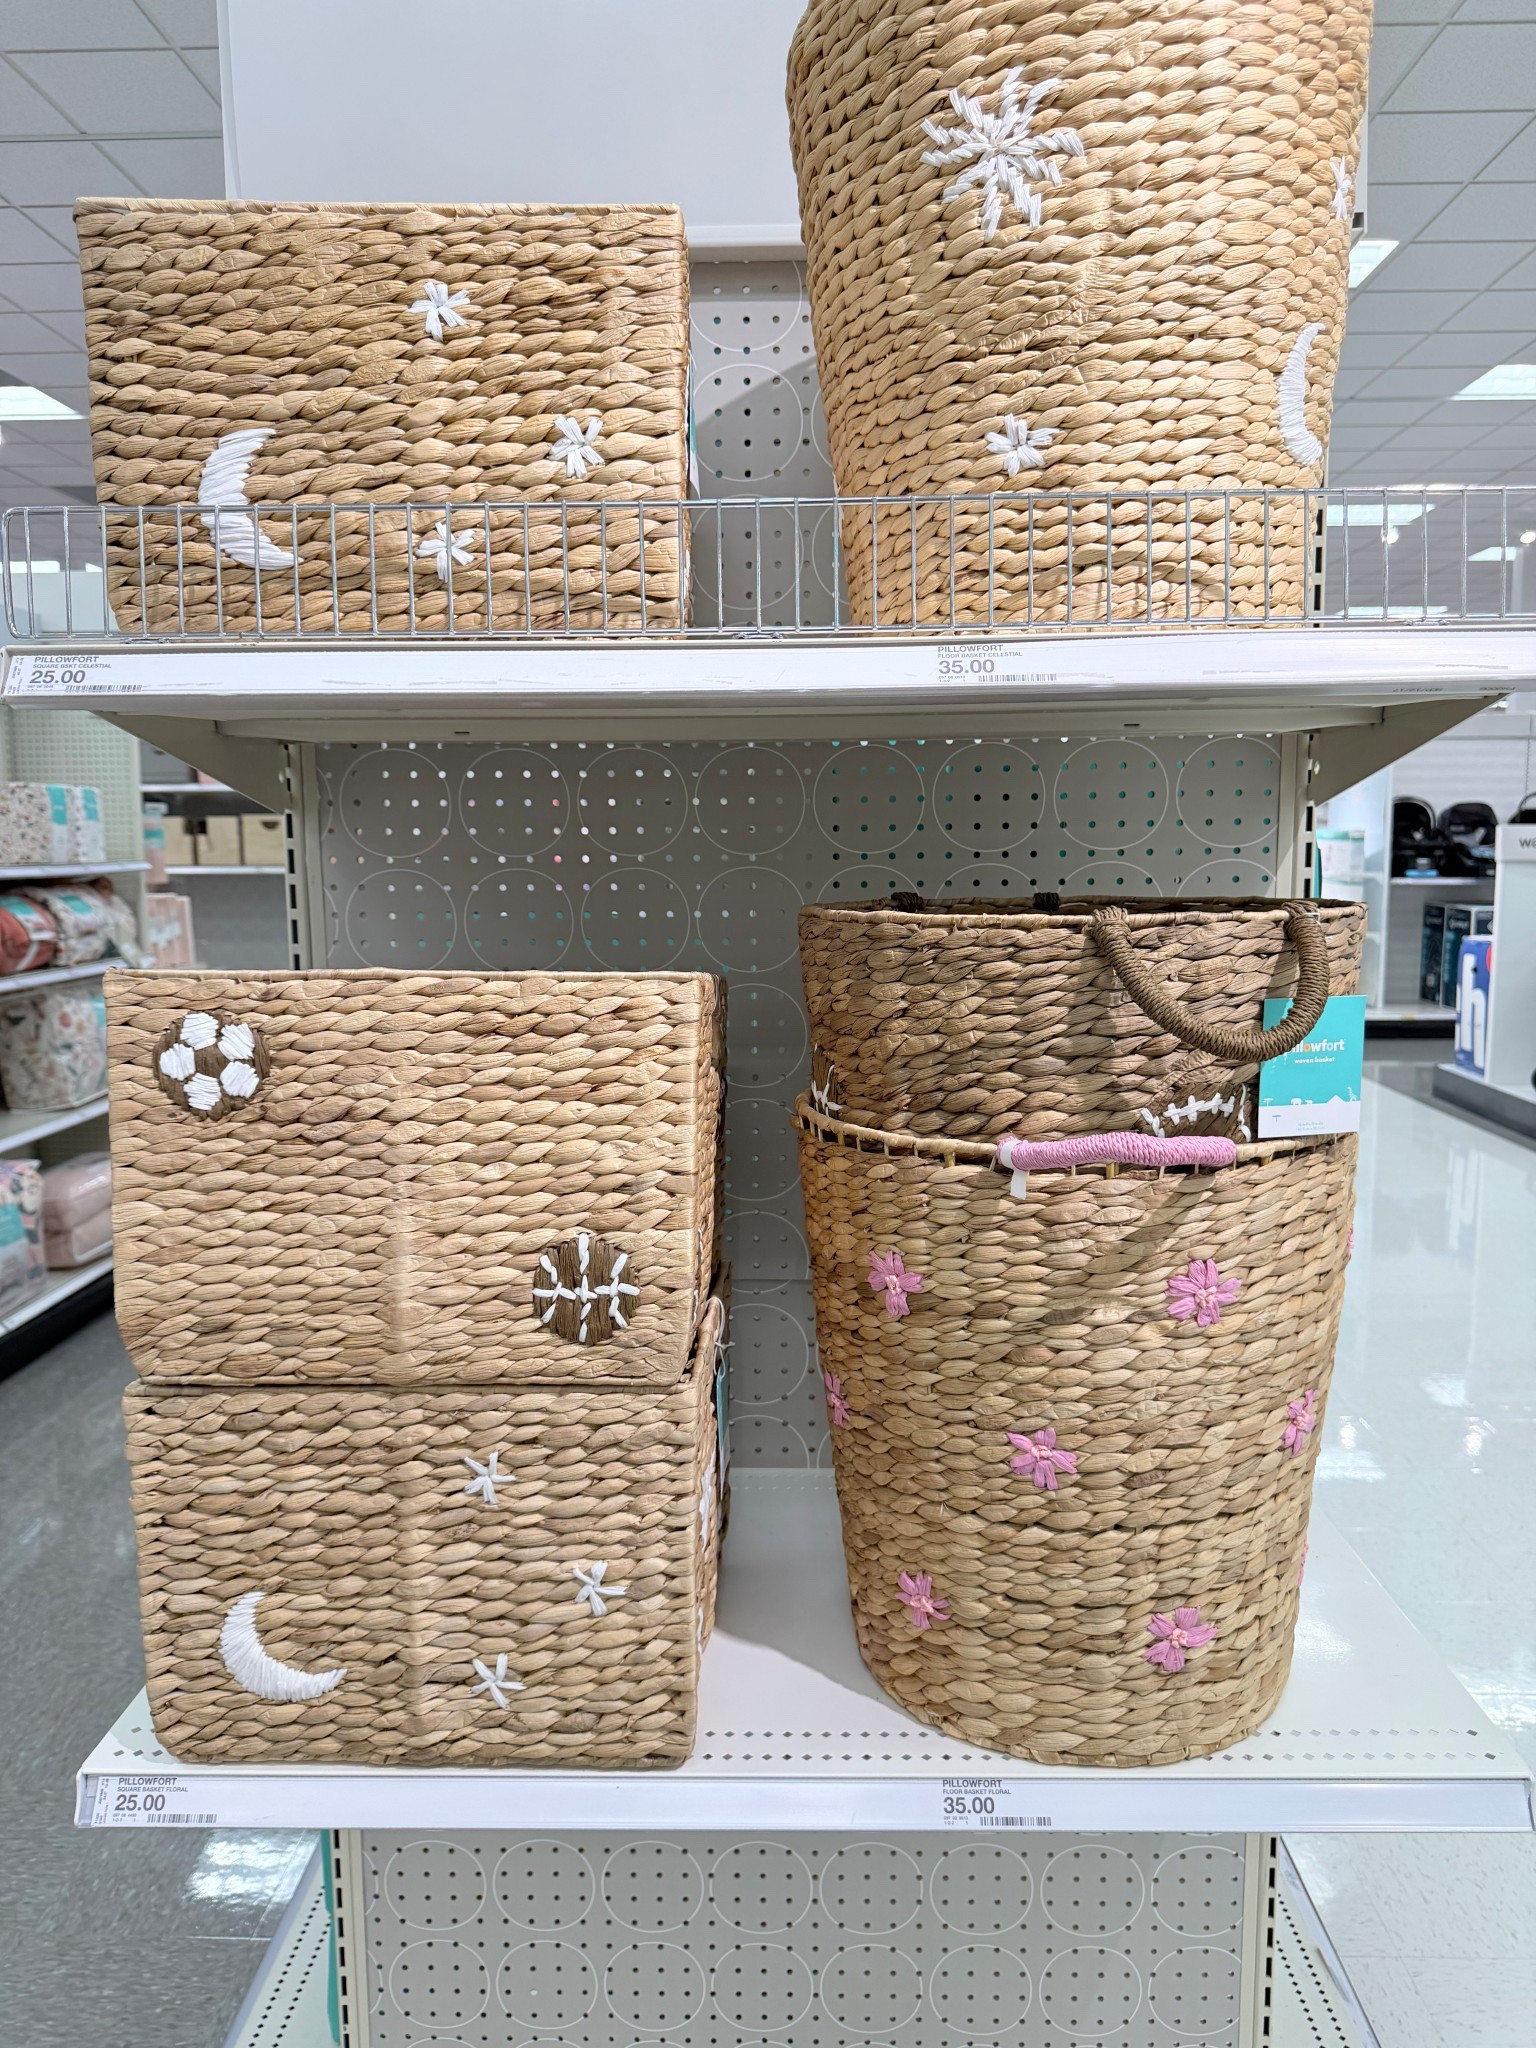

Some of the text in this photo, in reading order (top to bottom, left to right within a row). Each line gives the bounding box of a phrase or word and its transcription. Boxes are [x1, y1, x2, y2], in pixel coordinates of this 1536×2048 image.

[937, 644, 1004, 653] PILLOWFORT
[938, 659, 995, 674] 35.00
[29, 669, 86, 684] 25.00
[1291, 1037, 1346, 1054] llowfort
[1314, 1055, 1336, 1063] basket
[118, 1777, 178, 1785] PILLOWFORT
[942, 1779, 1003, 1788] PILLOWFORT
[114, 1794, 166, 1811] 25.00
[943, 1796, 995, 1814] 35.00
